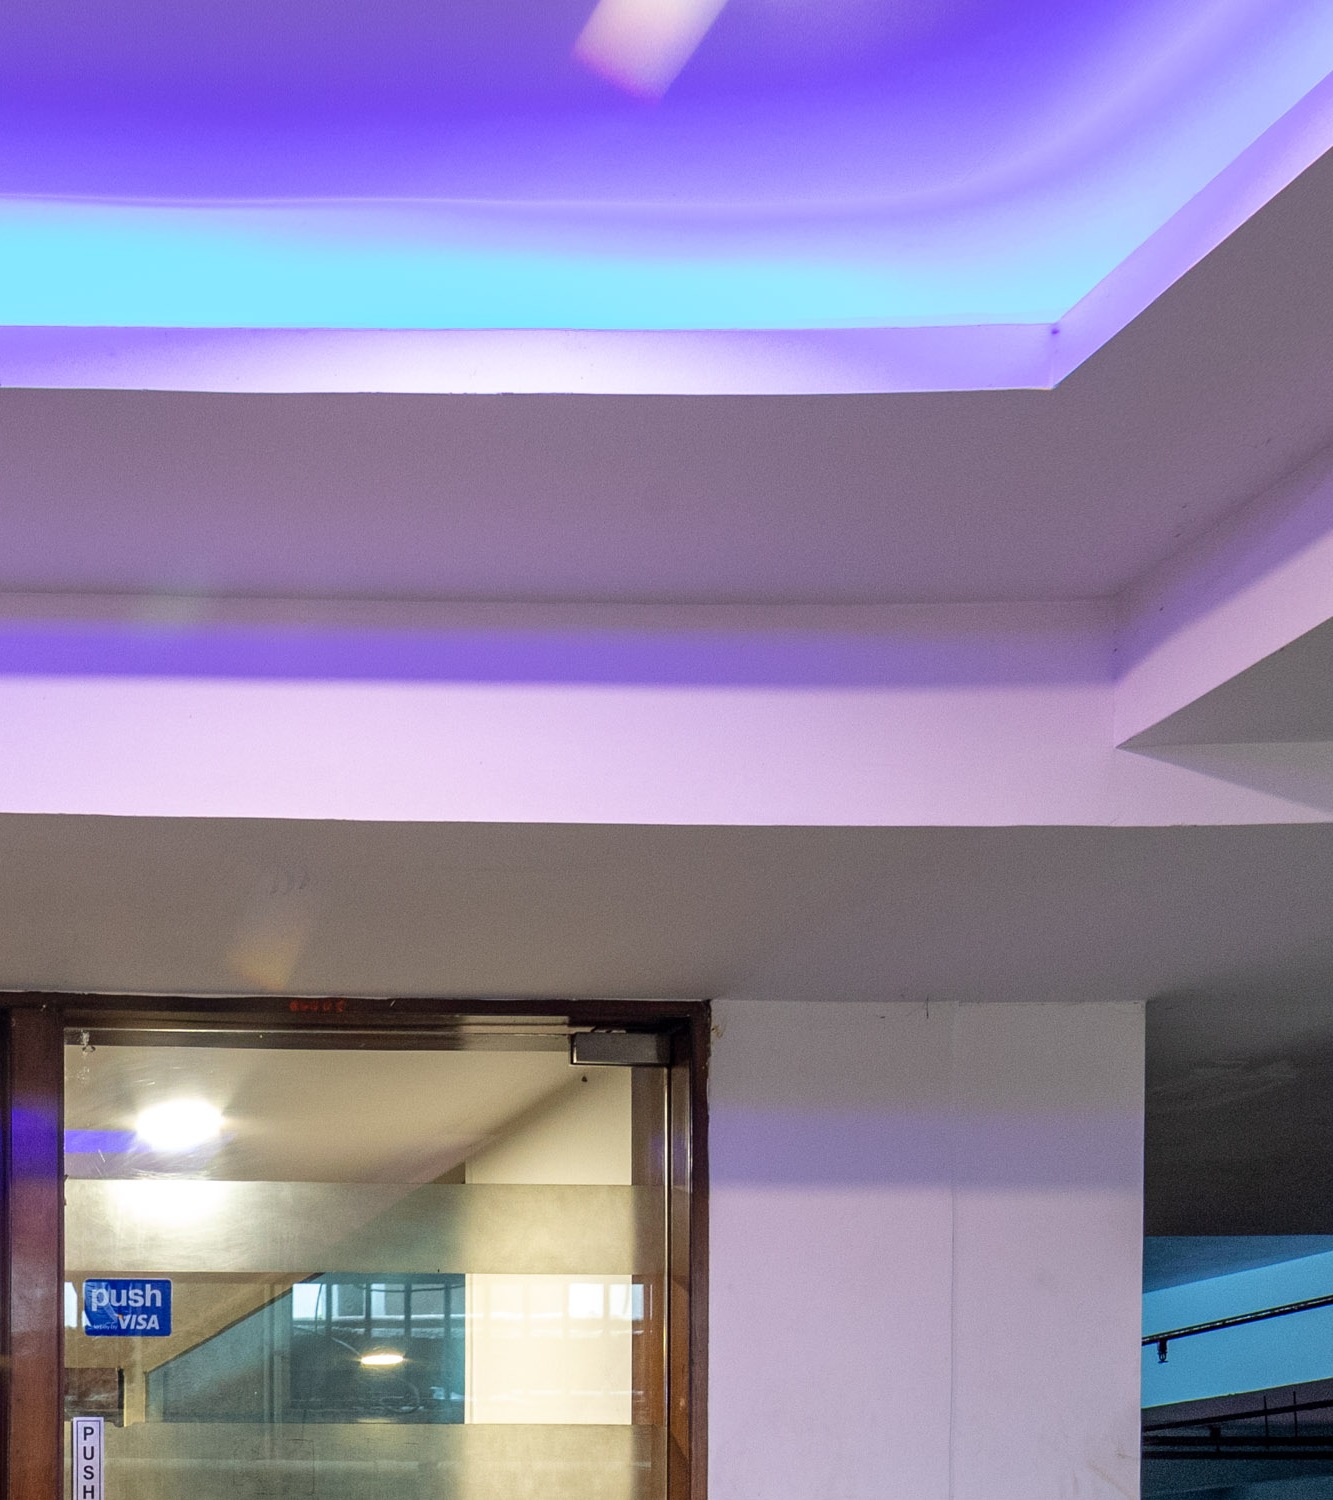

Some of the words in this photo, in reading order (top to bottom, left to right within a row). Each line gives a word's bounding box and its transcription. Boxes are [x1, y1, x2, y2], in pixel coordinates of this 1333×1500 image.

[91, 1283, 162, 1312] push
[117, 1314, 160, 1330] VISA
[83, 1426, 95, 1500] PUSH
